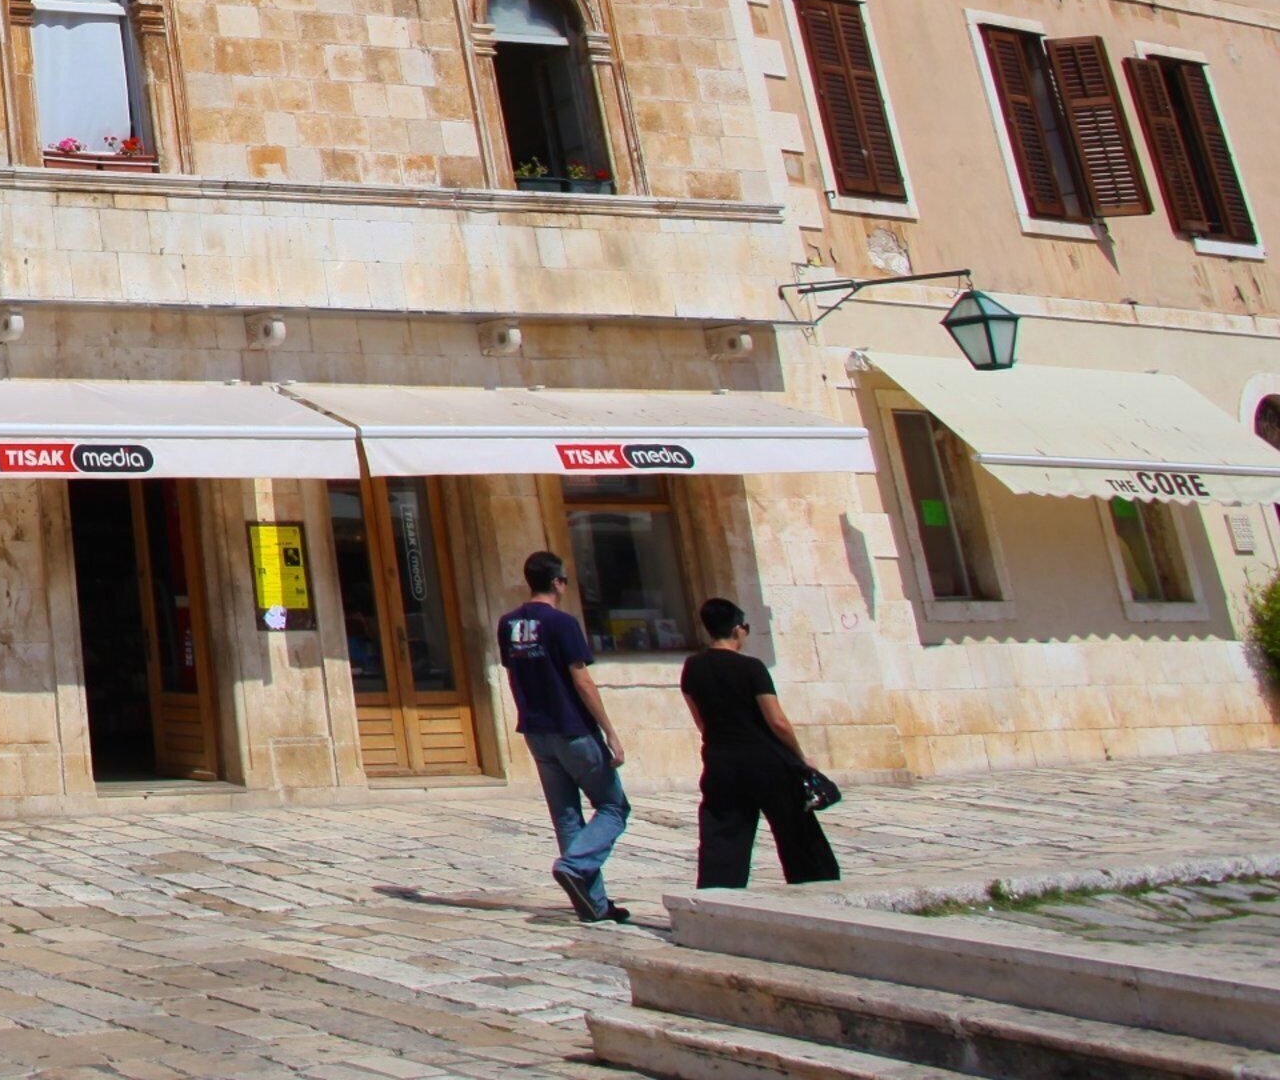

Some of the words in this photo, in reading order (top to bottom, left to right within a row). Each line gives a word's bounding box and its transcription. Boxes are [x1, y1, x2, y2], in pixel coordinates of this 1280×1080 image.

[5, 449, 65, 466] TISAK
[82, 448, 145, 467] media
[564, 449, 620, 464] TISAK
[631, 447, 687, 464] media
[1105, 479, 1138, 493] THE
[1136, 471, 1210, 496] CORE
[404, 511, 417, 546] TISAK
[411, 555, 423, 594] media
